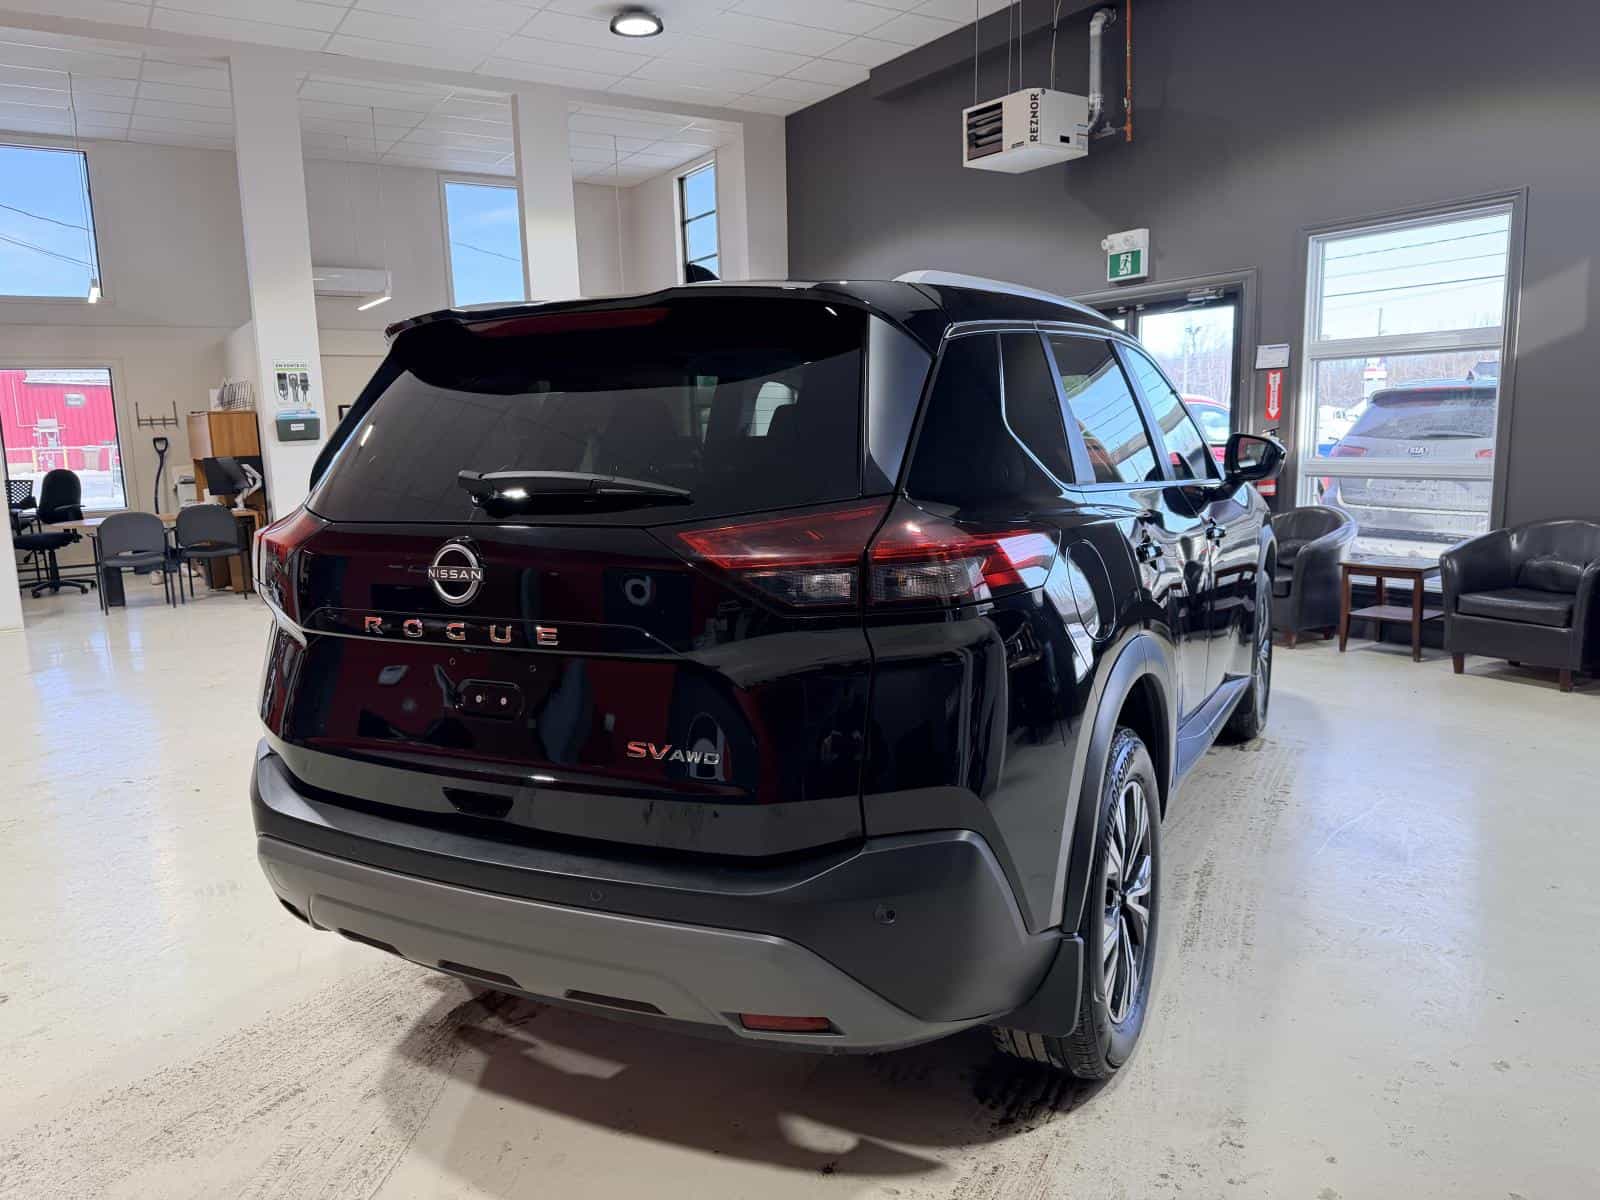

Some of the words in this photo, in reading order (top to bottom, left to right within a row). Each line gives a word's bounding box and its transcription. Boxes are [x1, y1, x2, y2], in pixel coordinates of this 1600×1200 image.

[1029, 92, 1040, 143] REZNOR
[428, 568, 481, 580] NISSAN
[364, 615, 560, 647] ROGUE
[626, 740, 673, 760] SV
[668, 749, 720, 765] AWD
